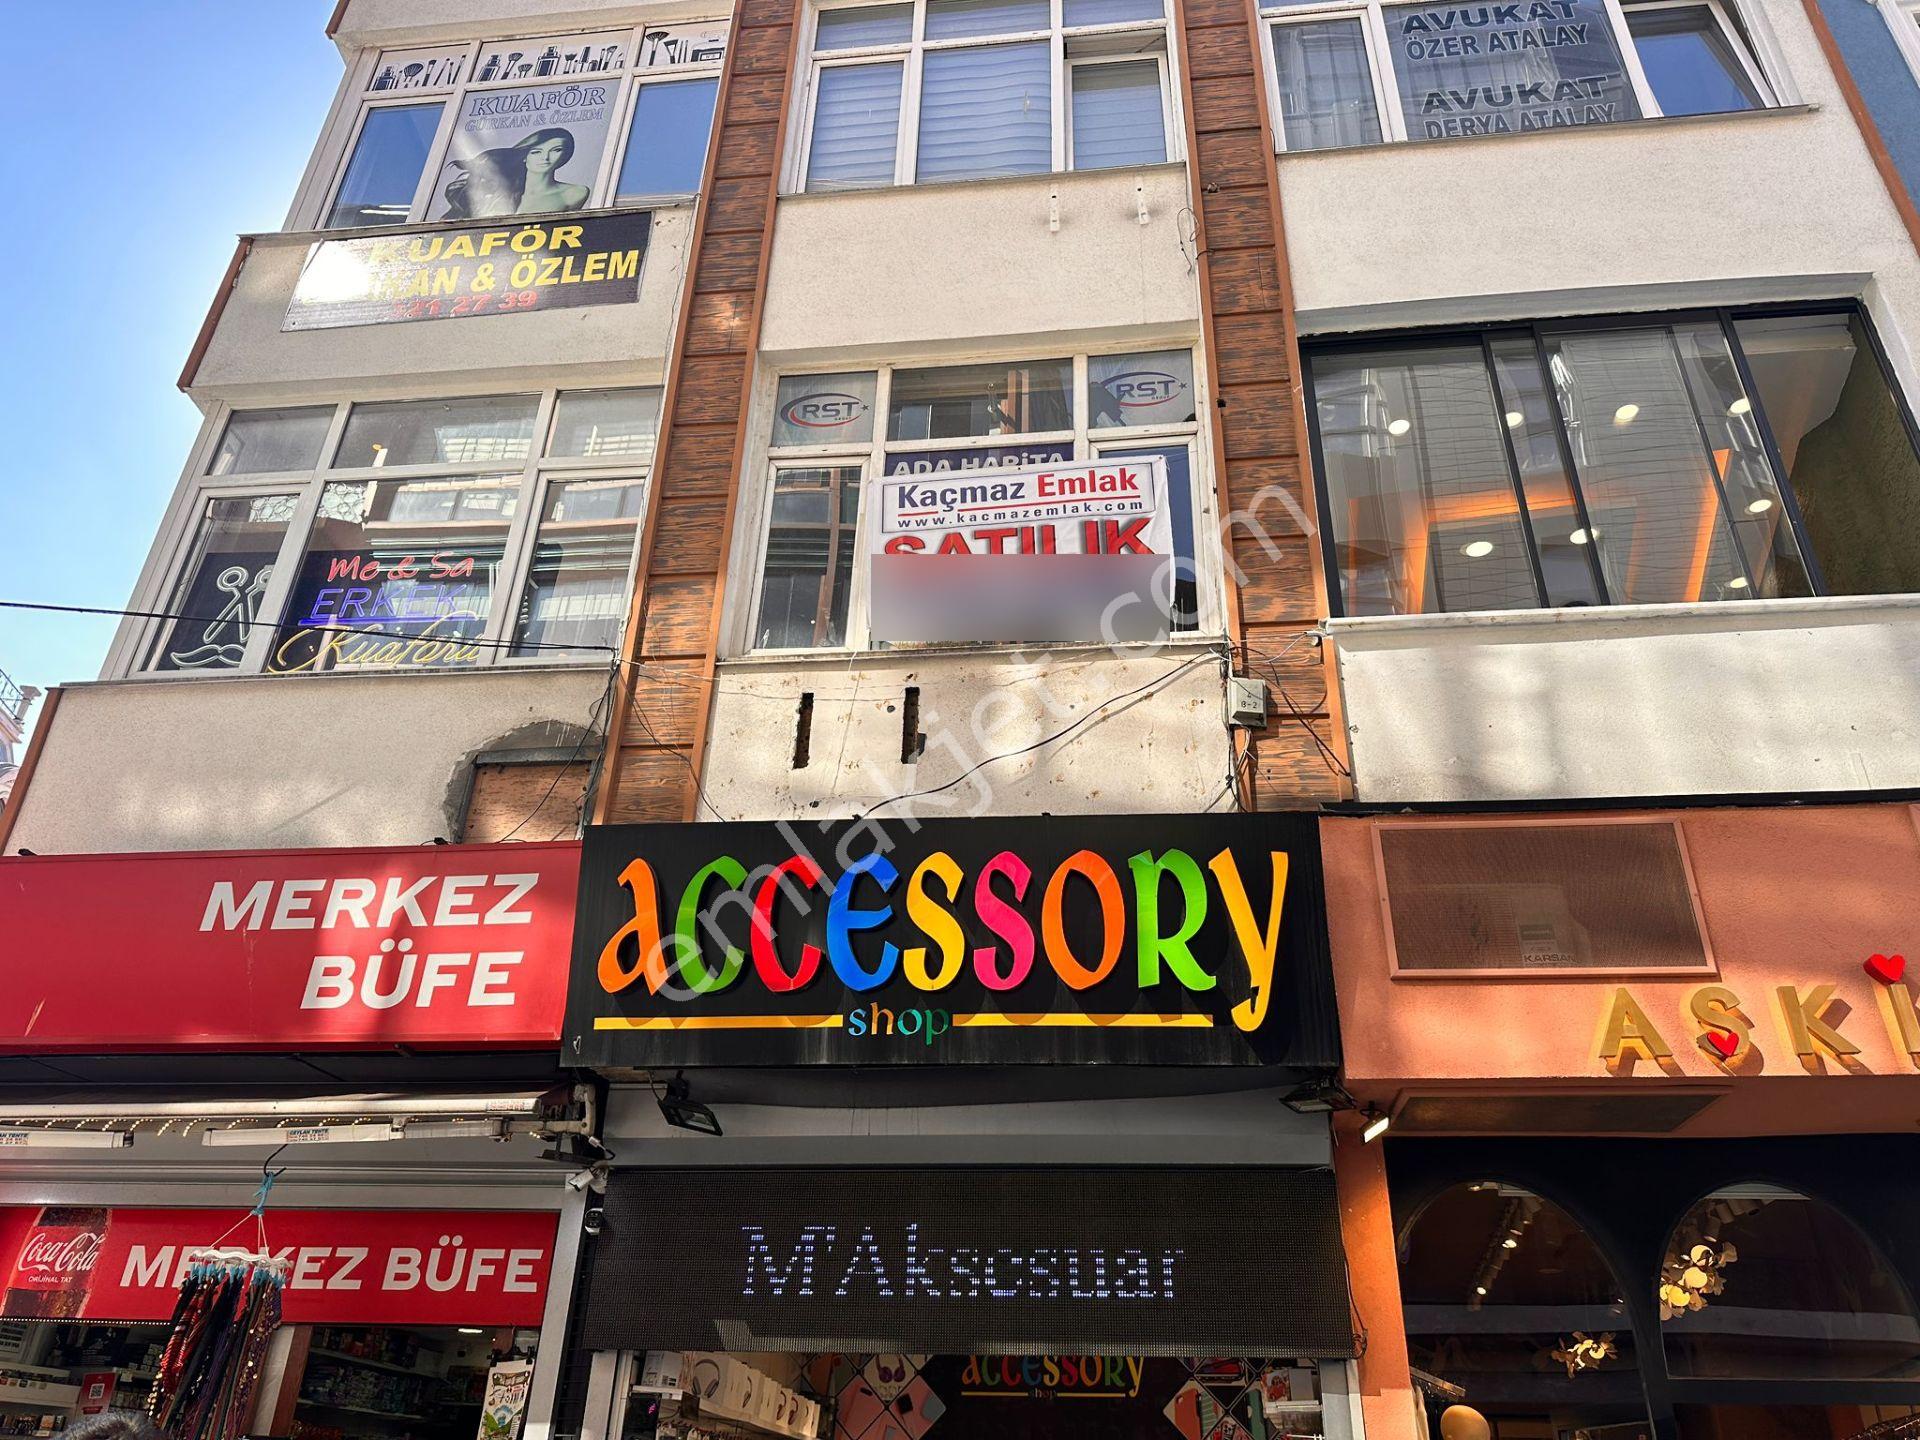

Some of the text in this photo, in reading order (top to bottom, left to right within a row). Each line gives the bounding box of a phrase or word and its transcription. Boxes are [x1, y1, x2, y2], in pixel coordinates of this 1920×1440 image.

[1402, 0, 1580, 34] AVUKAT
[1404, 22, 1589, 61] ÖZER ATALAY
[469, 84, 606, 116] KUAFÖR
[1421, 75, 1608, 115] AVUKAT
[464, 107, 604, 132] GÜRKAN & ÖZLEM
[1423, 102, 1617, 140] DERYA ATALAY
[469, 263, 496, 292] &
[510, 249, 640, 290] ÖZLEM
[450, 295, 491, 315] 27
[497, 291, 538, 310] 39
[1116, 379, 1175, 398] RST
[801, 401, 860, 420] RST
[893, 459, 955, 476] ADA
[897, 467, 1140, 513] Kaçmaz Emlak
[897, 499, 1144, 529] www.kacmazemlak.com
[327, 556, 379, 582] Me
[429, 551, 475, 579] Sa
[310, 584, 467, 619] ERKEK
[200, 873, 539, 931] MERKEZ
[300, 938, 524, 1010] BÜFE
[848, 1003, 950, 1046] shop
[18, 1232, 106, 1273] Coca-Cola
[381, 1234, 543, 1294] BÜFE
